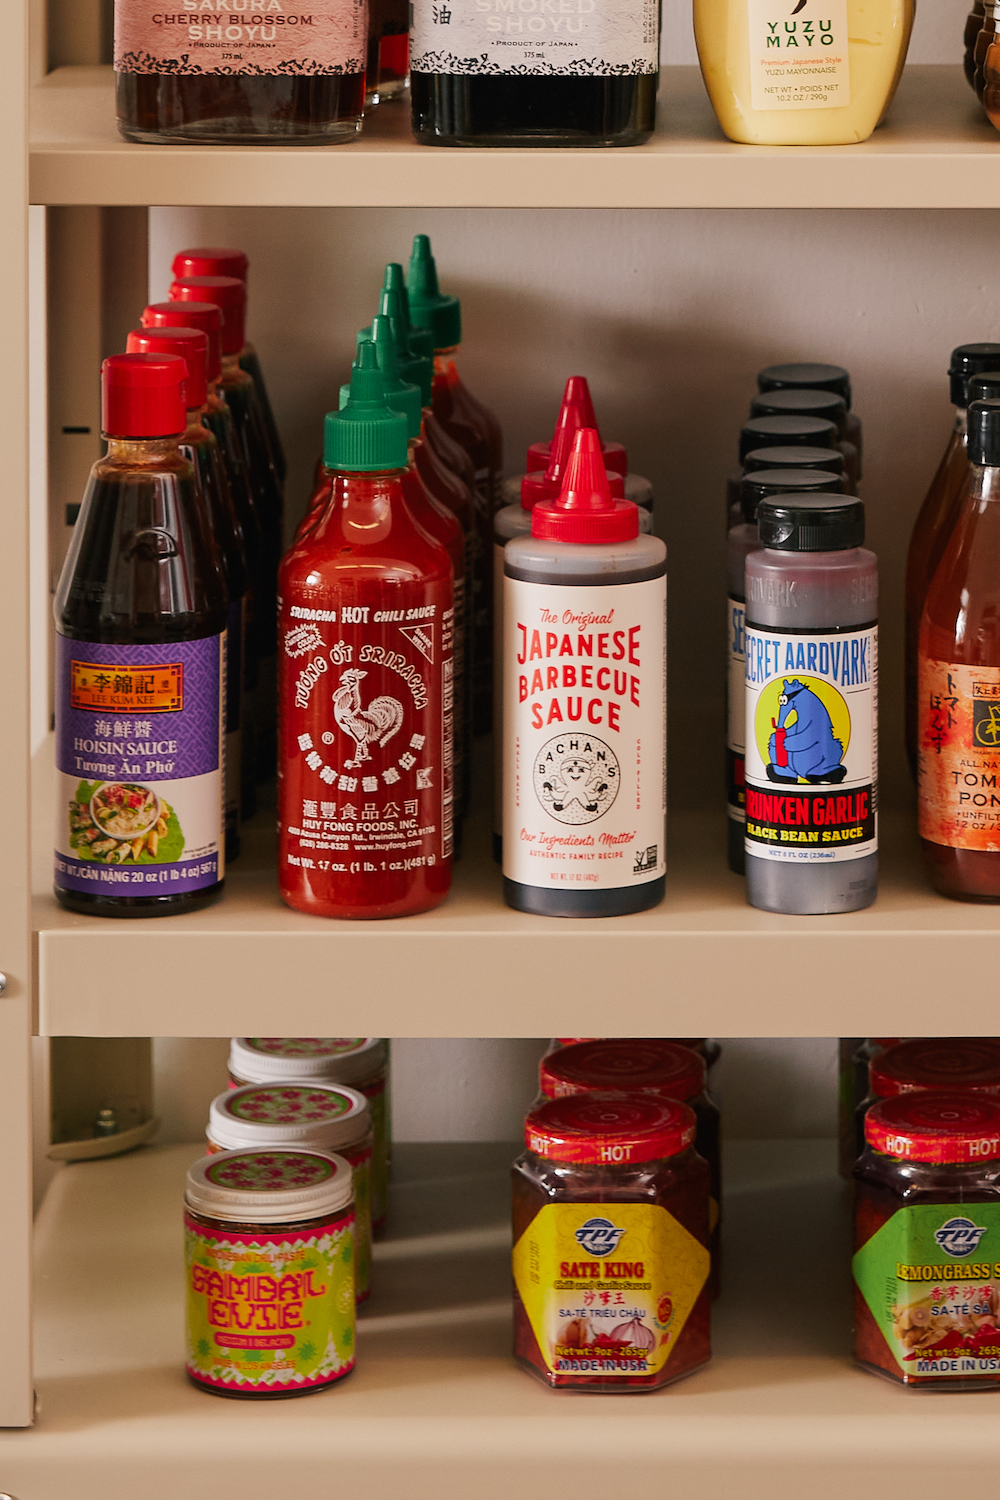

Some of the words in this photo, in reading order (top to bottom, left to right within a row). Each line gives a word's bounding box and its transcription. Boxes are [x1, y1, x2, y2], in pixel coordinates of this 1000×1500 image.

[152, 15, 223, 24] CHERRY
[229, 15, 313, 25] BLOSSOM
[486, 18, 583, 32] SHOYU
[767, 20, 832, 34] YUZU
[188, 26, 276, 40] SHOYU
[766, 34, 834, 48] MAYO
[787, 67, 836, 75] MAYONNAISE
[290, 605, 336, 622] SRIRACHA
[341, 607, 370, 624] HOT
[374, 609, 404, 622] CHILI
[406, 605, 436, 621] SAUCE
[539, 607, 558, 624] The
[562, 608, 615, 631] Original
[517, 622, 641, 667] JAPANESE
[745, 637, 781, 683] ECRET
[785, 636, 868, 687] AARDVARK
[92, 673, 155, 694] 李錦記
[519, 664, 641, 708] BARBECUE
[92, 695, 106, 704] LEE
[110, 696, 134, 705] KUM
[136, 696, 155, 704] KEE
[531, 696, 621, 732] SAUCE
[95, 720, 152, 739] 海鮮醬
[74, 737, 124, 755] HOISIN
[127, 740, 177, 756] SAUCE
[538, 740, 616, 777] BACHAN'S
[960, 759, 977, 768] ALL
[812, 791, 868, 826] GARLIC
[302, 819, 321, 829] HUY
[323, 821, 353, 831] FONG
[356, 822, 397, 832] FOODS,
[400, 819, 419, 829] INC.
[747, 822, 778, 840] BLACK
[780, 829, 818, 842] BEAN
[822, 826, 863, 842] SAUCE
[601, 1146, 631, 1162] HOT
[886, 1137, 913, 1155] HOT
[969, 1138, 1000, 1157] HOT
[575, 1227, 626, 1244] TPF
[560, 1262, 600, 1278] SATE
[604, 1262, 644, 1278] KING
[896, 1260, 990, 1282] LEMONGRASS
[917, 1358, 958, 1372] MADE
[961, 1358, 976, 1371] IN
